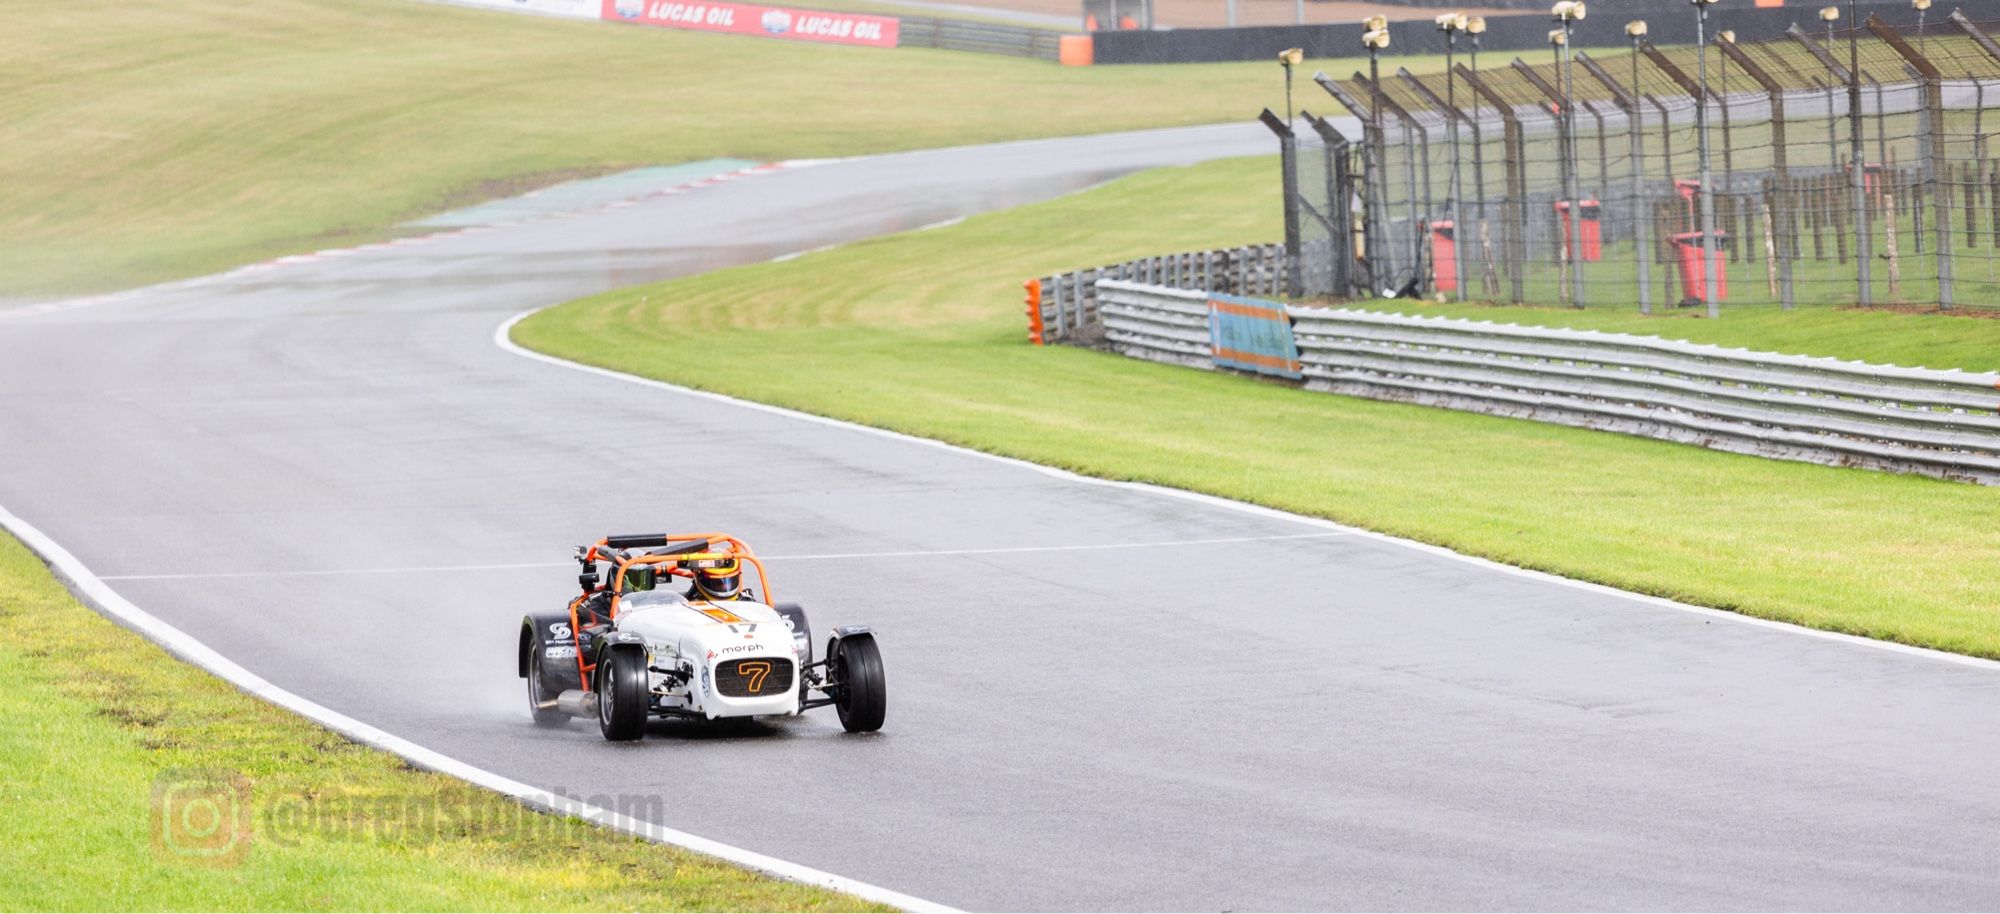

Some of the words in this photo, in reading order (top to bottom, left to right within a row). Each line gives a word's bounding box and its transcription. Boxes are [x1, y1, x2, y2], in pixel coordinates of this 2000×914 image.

[648, 2, 705, 23] LUCAS
[706, 7, 734, 26] OIL
[795, 16, 853, 38] LUCAS
[854, 21, 882, 40] OIL
[722, 643, 764, 654] morph
[738, 661, 771, 693] 7
